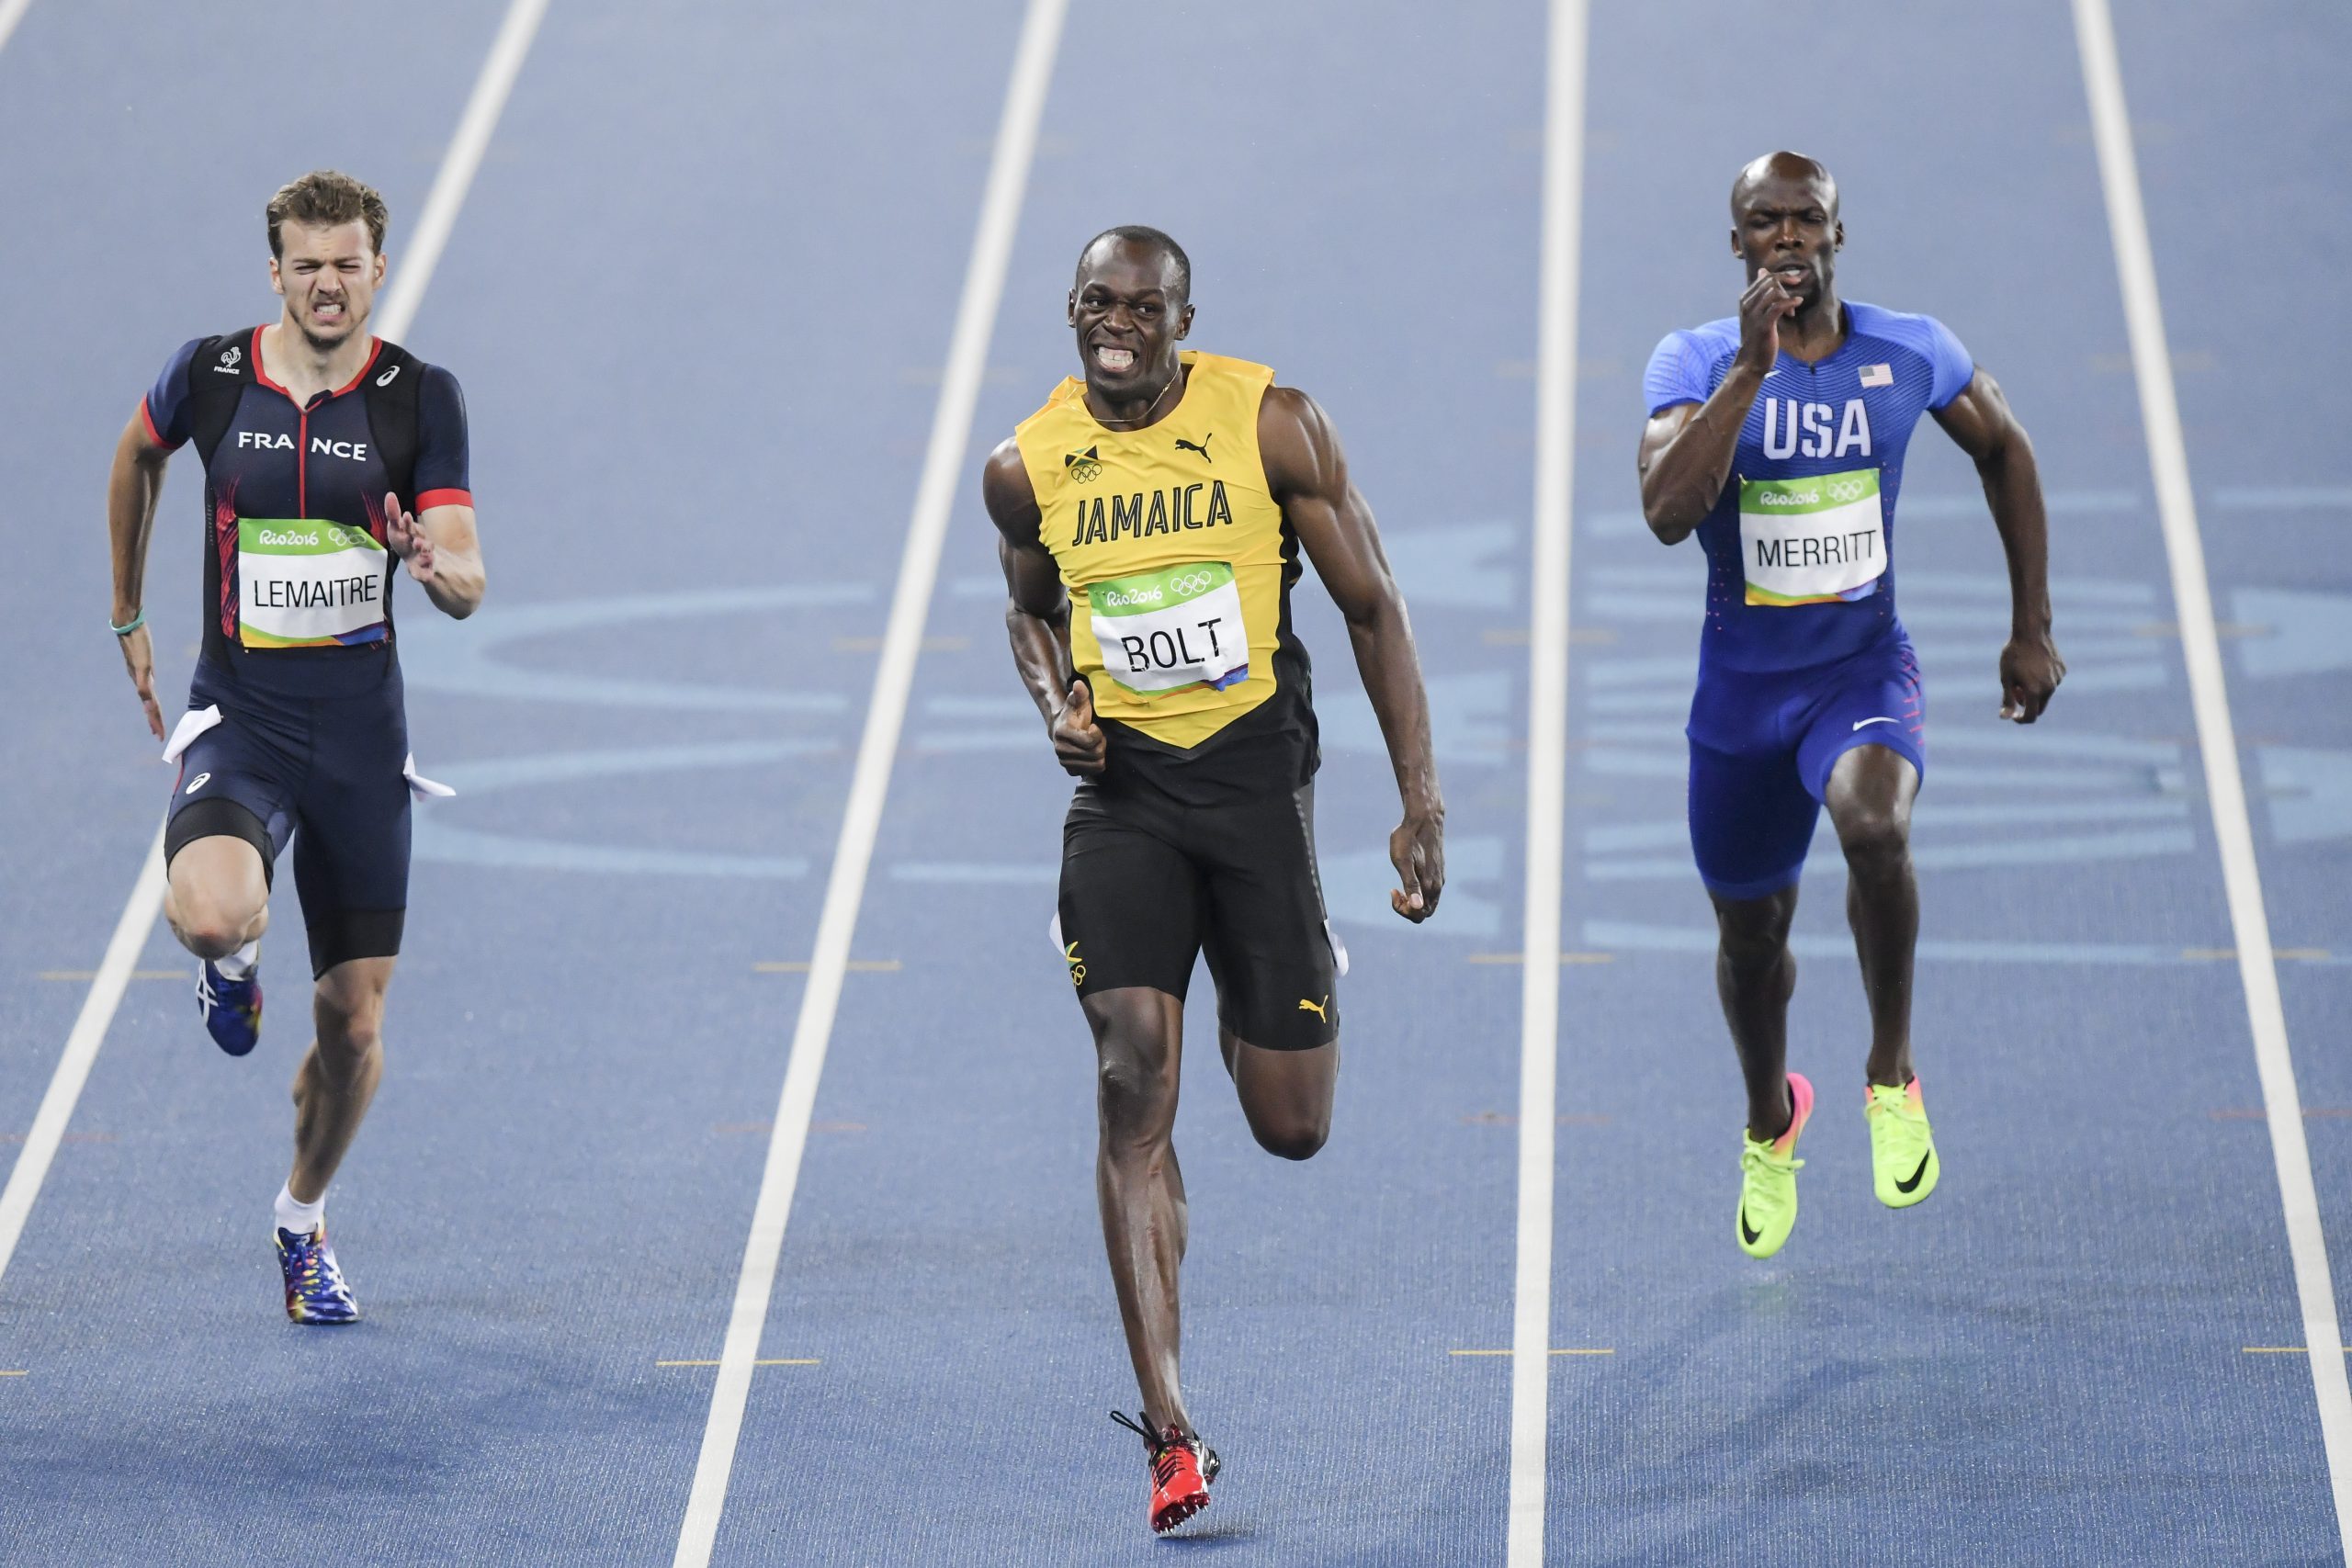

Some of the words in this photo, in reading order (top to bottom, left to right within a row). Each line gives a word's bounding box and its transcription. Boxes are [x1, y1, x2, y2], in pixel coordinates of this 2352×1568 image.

[213, 366, 240, 375] FRANCE
[1763, 398, 1871, 460] USA
[1072, 479, 1233, 547] JAMAICA
[1757, 530, 1876, 568] MERRITT
[254, 575, 378, 609] LEMAITRE
[1121, 617, 1222, 672] BOLT
